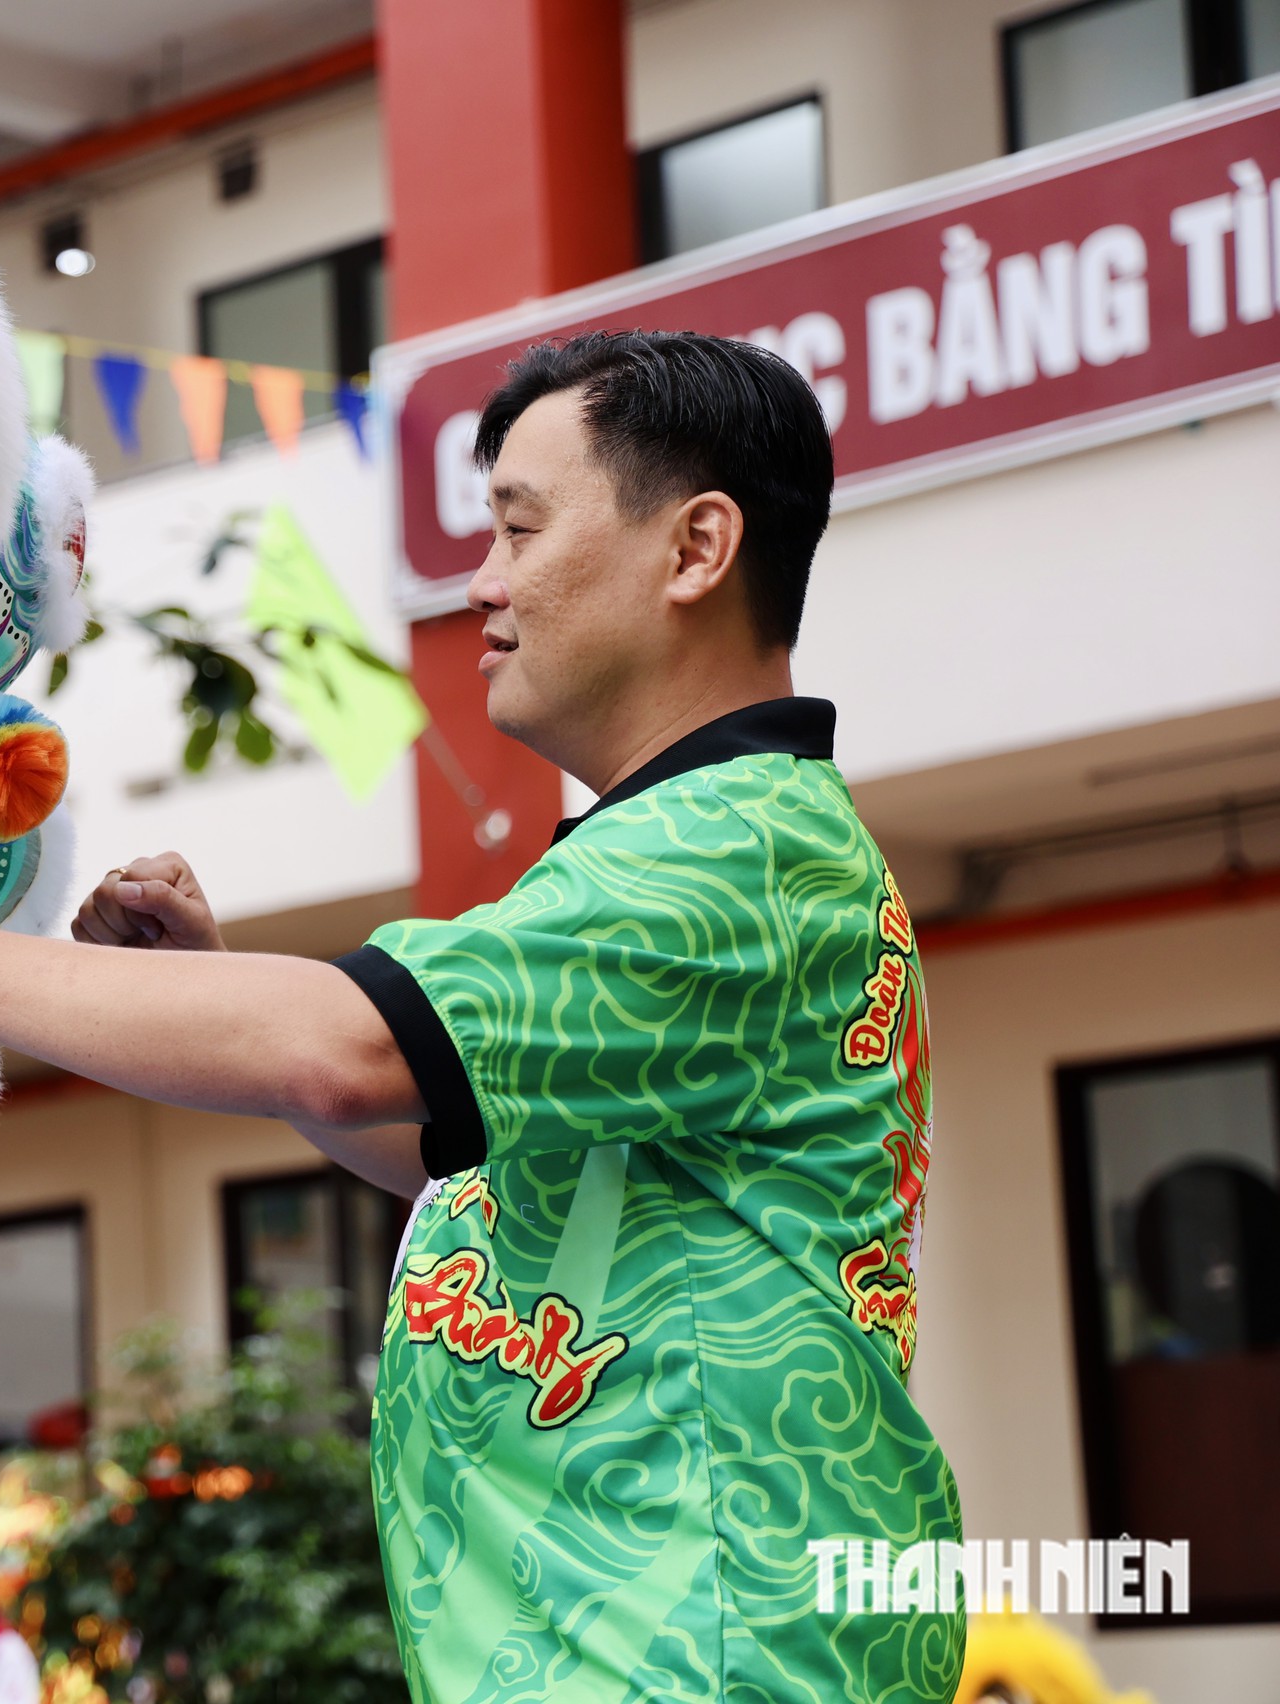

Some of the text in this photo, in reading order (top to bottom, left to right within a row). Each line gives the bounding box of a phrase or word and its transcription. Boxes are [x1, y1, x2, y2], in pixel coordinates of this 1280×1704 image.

[867, 224, 1151, 425] BẰNG
[1170, 158, 1280, 337] TÌ
[850, 960, 902, 1060] Đoàn
